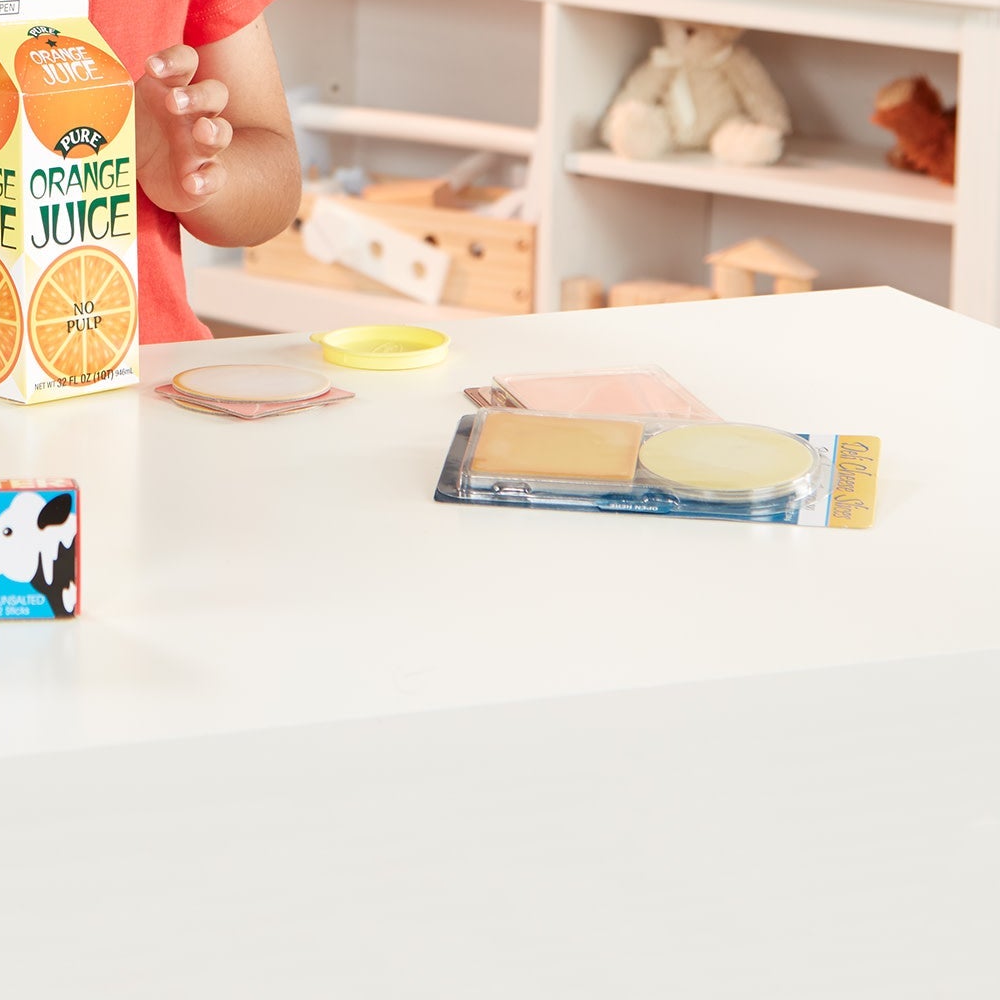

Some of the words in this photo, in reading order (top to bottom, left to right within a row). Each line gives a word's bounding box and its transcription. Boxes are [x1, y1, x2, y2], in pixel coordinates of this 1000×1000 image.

[30, 26, 56, 37] PURE
[29, 47, 92, 65] ORANGE
[41, 59, 103, 85] JUICE
[60, 128, 102, 151] PURE
[30, 157, 130, 199] ORANGE
[31, 193, 131, 249] JUICE
[73, 300, 95, 316] NO
[66, 315, 102, 333] PULP
[34, 382, 46, 391] NET
[47, 380, 56, 389] WT
[56, 377, 67, 388] 32
[69, 375, 79, 386] FL
[80, 372, 91, 383] OZ
[836, 462, 873, 492] Cheese
